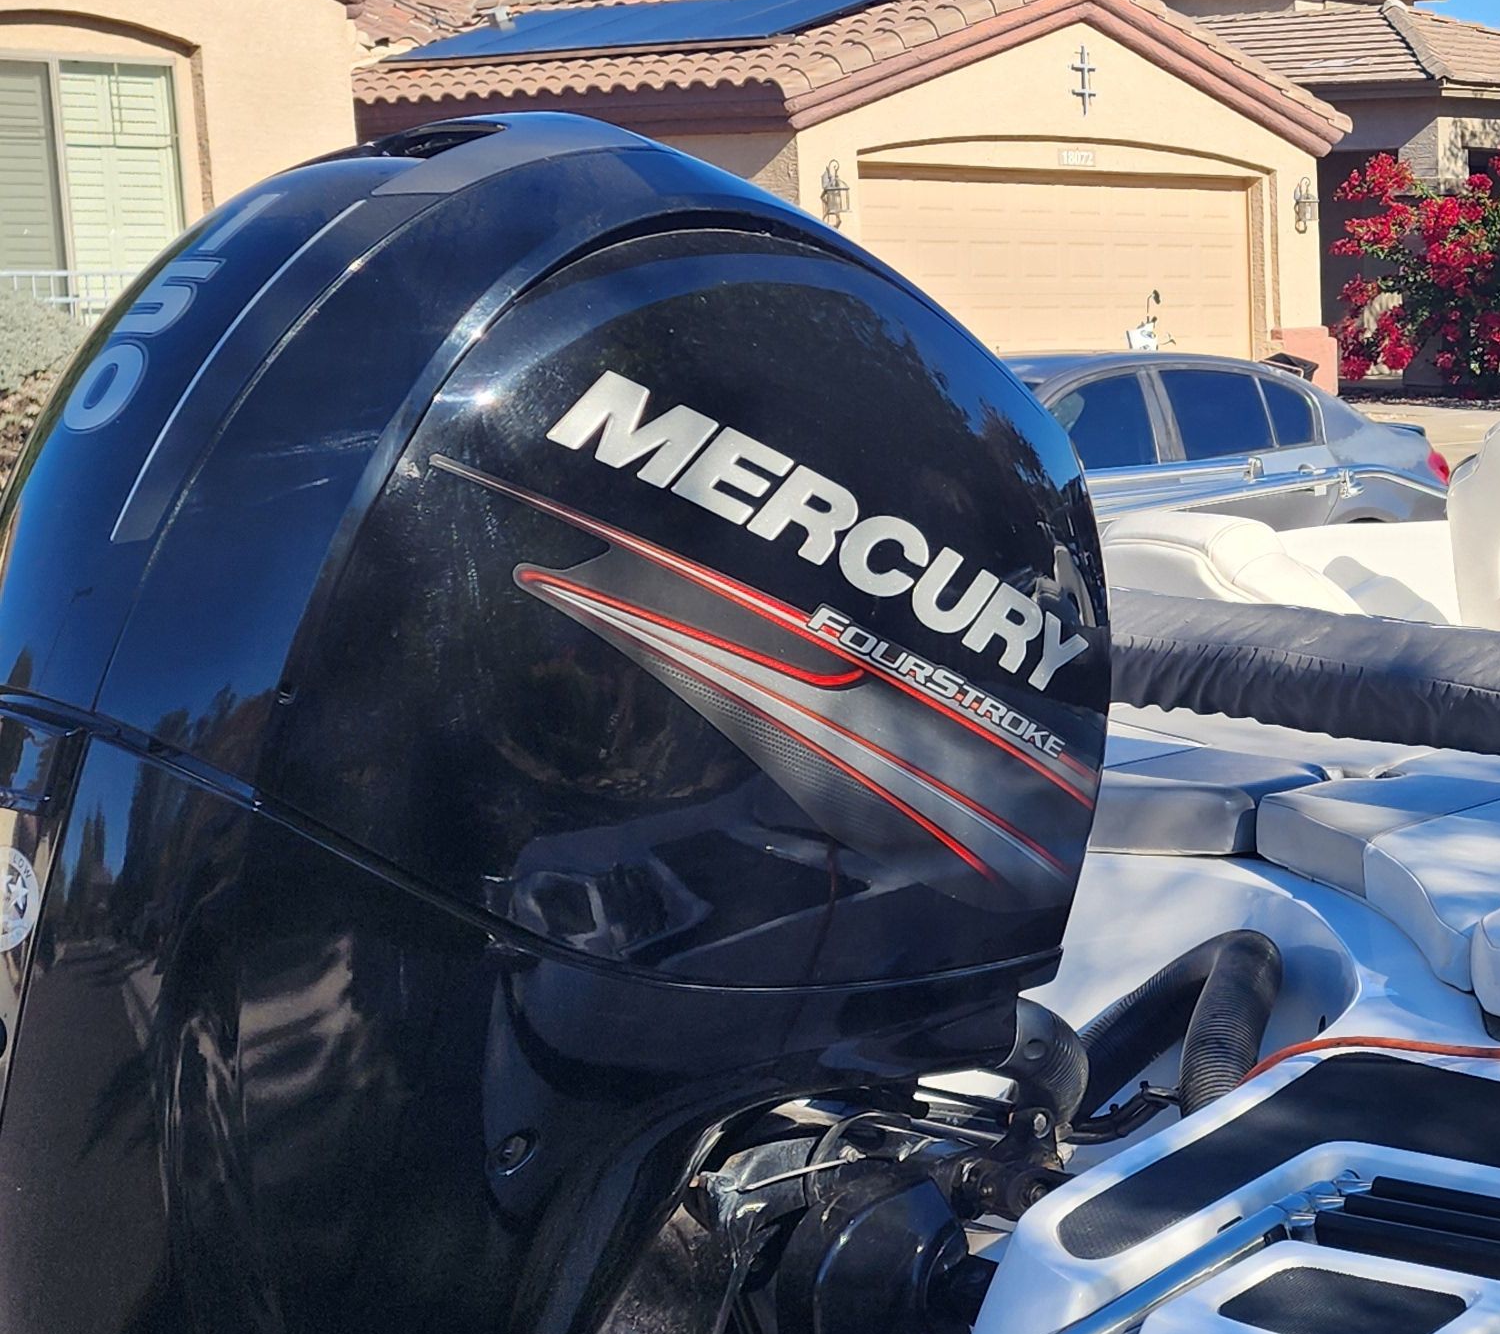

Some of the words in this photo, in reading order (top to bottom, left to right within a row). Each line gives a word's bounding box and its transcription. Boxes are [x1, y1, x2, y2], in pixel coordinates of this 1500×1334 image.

[1062, 150, 1095, 166] 18072
[546, 370, 1089, 692] MERCURY
[806, 608, 1066, 759] FOURSTROKE
